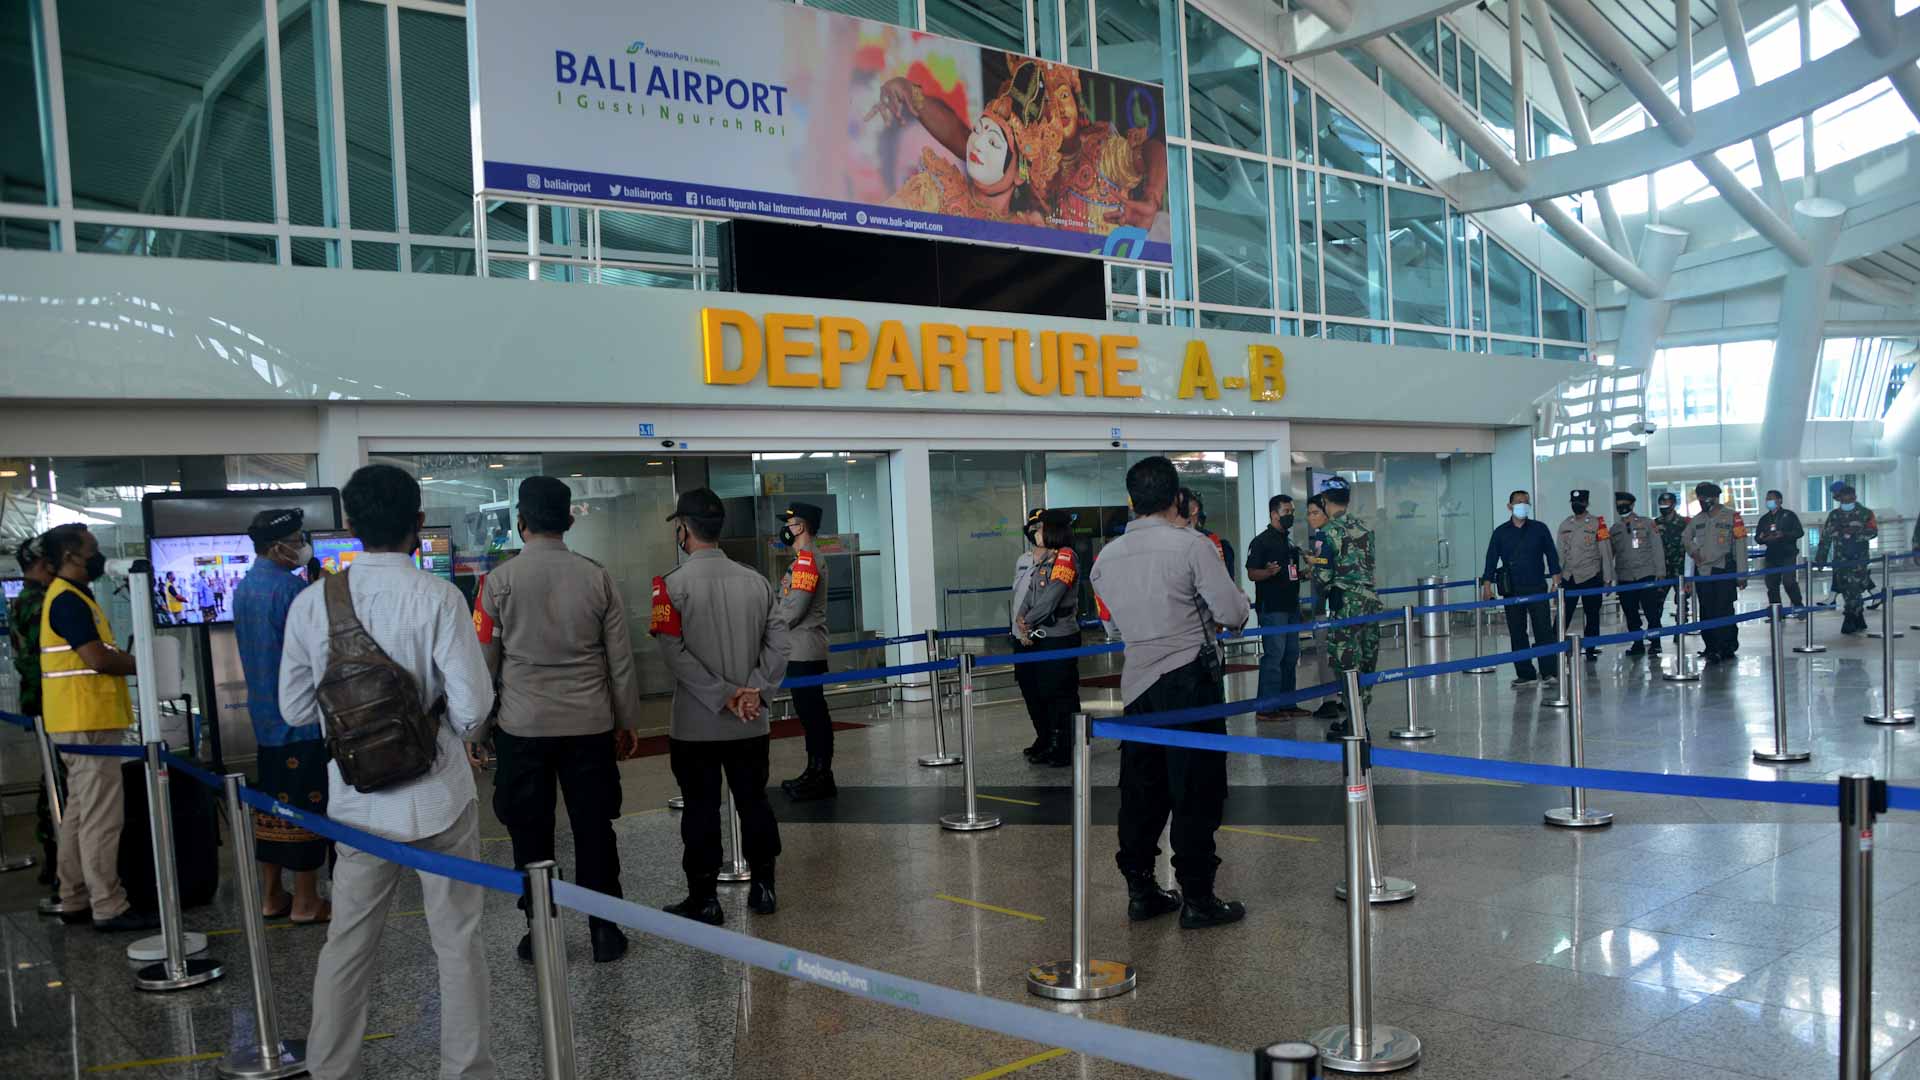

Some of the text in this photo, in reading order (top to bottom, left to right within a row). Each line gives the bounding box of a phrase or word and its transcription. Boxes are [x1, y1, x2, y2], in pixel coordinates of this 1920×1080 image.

[555, 50, 788, 117] BALI AIRPORT
[576, 94, 645, 117] Gusti
[659, 105, 743, 130] Ngurah
[754, 119, 785, 136] Rai
[543, 177, 592, 193] baliairport
[623, 186, 673, 201] baliairports
[705, 195, 727, 207] Gusti
[728, 198, 757, 211] Ngurah
[758, 201, 772, 212] Rai
[773, 204, 821, 218] International
[821, 208, 848, 222] Airport
[869, 215, 943, 232] www.bali-airport.com
[701, 307, 1143, 397] DEPARTURE
